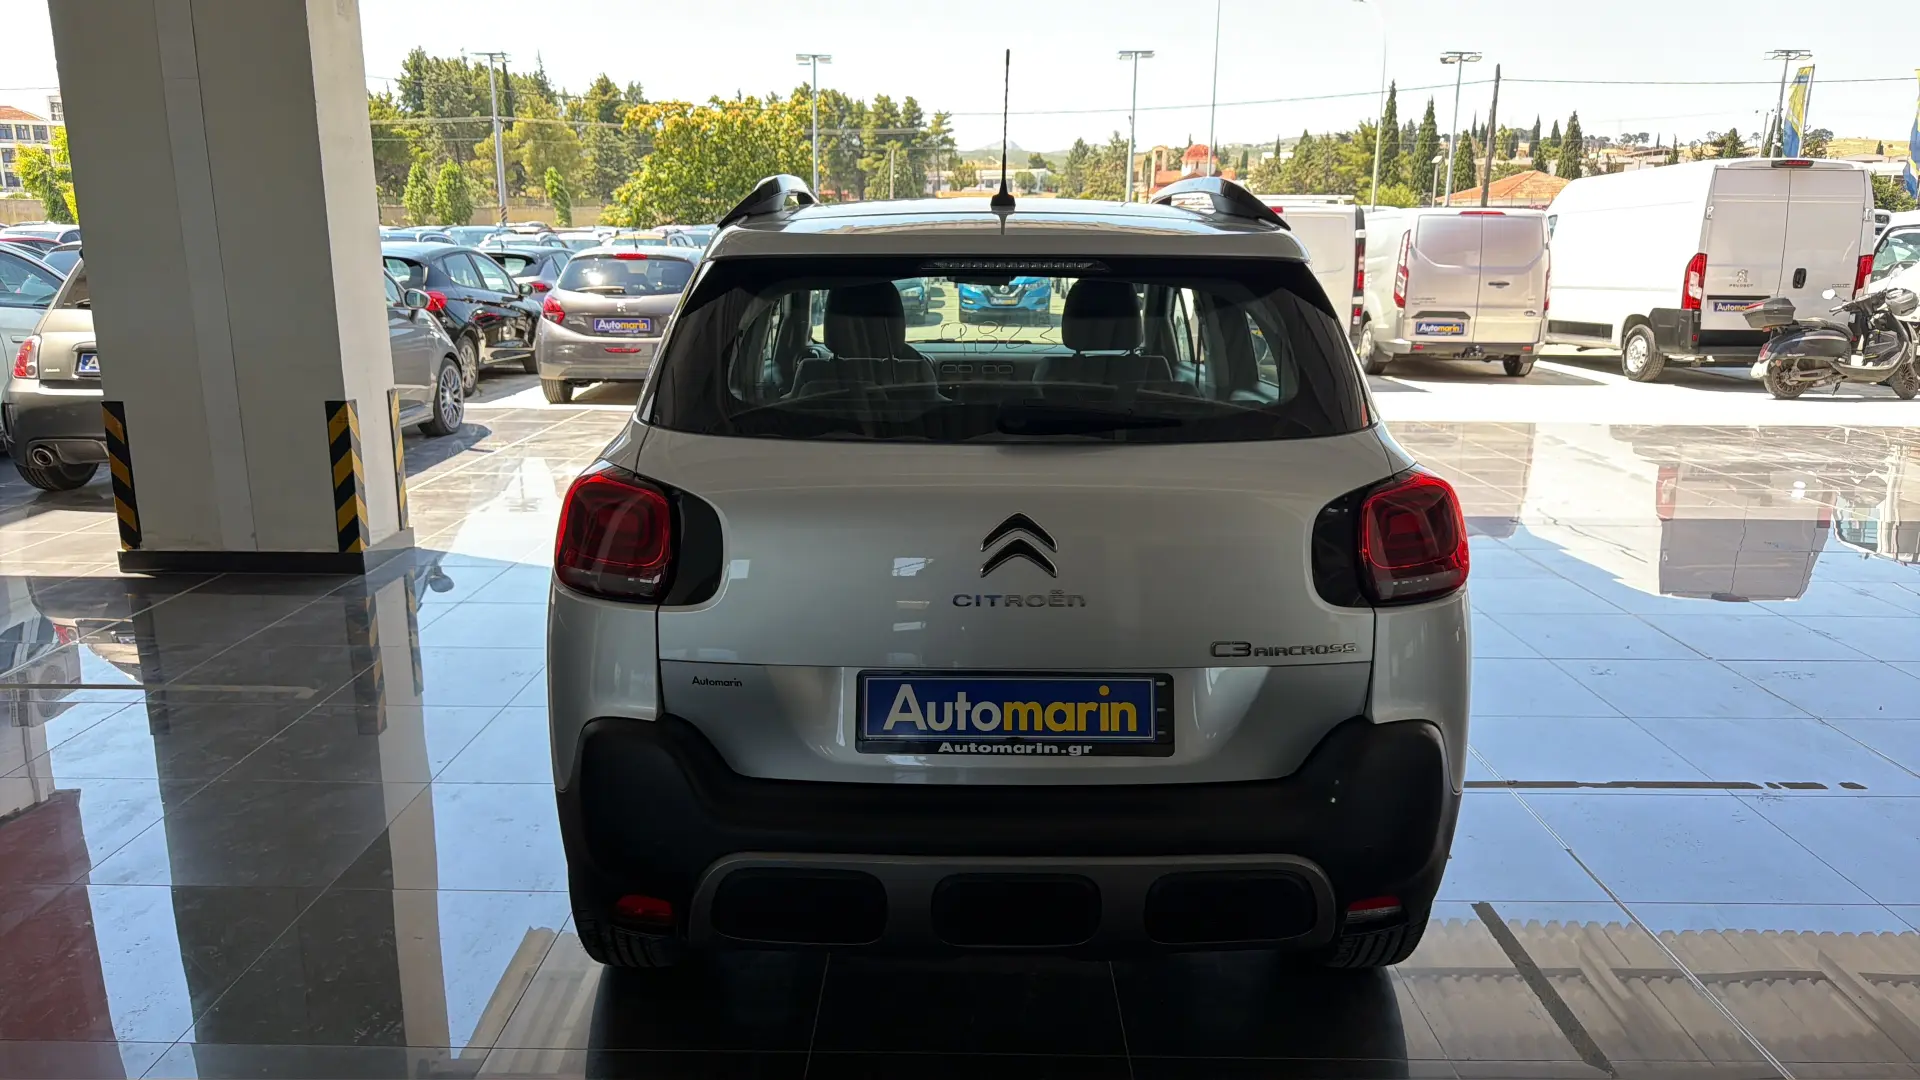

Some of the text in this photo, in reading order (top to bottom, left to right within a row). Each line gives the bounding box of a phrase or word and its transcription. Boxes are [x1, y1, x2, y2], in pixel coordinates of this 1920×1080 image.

[1717, 303, 1748, 312] Automa
[598, 319, 647, 330] Automarin
[1420, 323, 1460, 332] Automarin
[1210, 640, 1357, 657] C3 AIRCROSS
[692, 676, 743, 687] Automarin
[883, 683, 1138, 732] Automarin
[938, 742, 1093, 756] Automarin.gr
